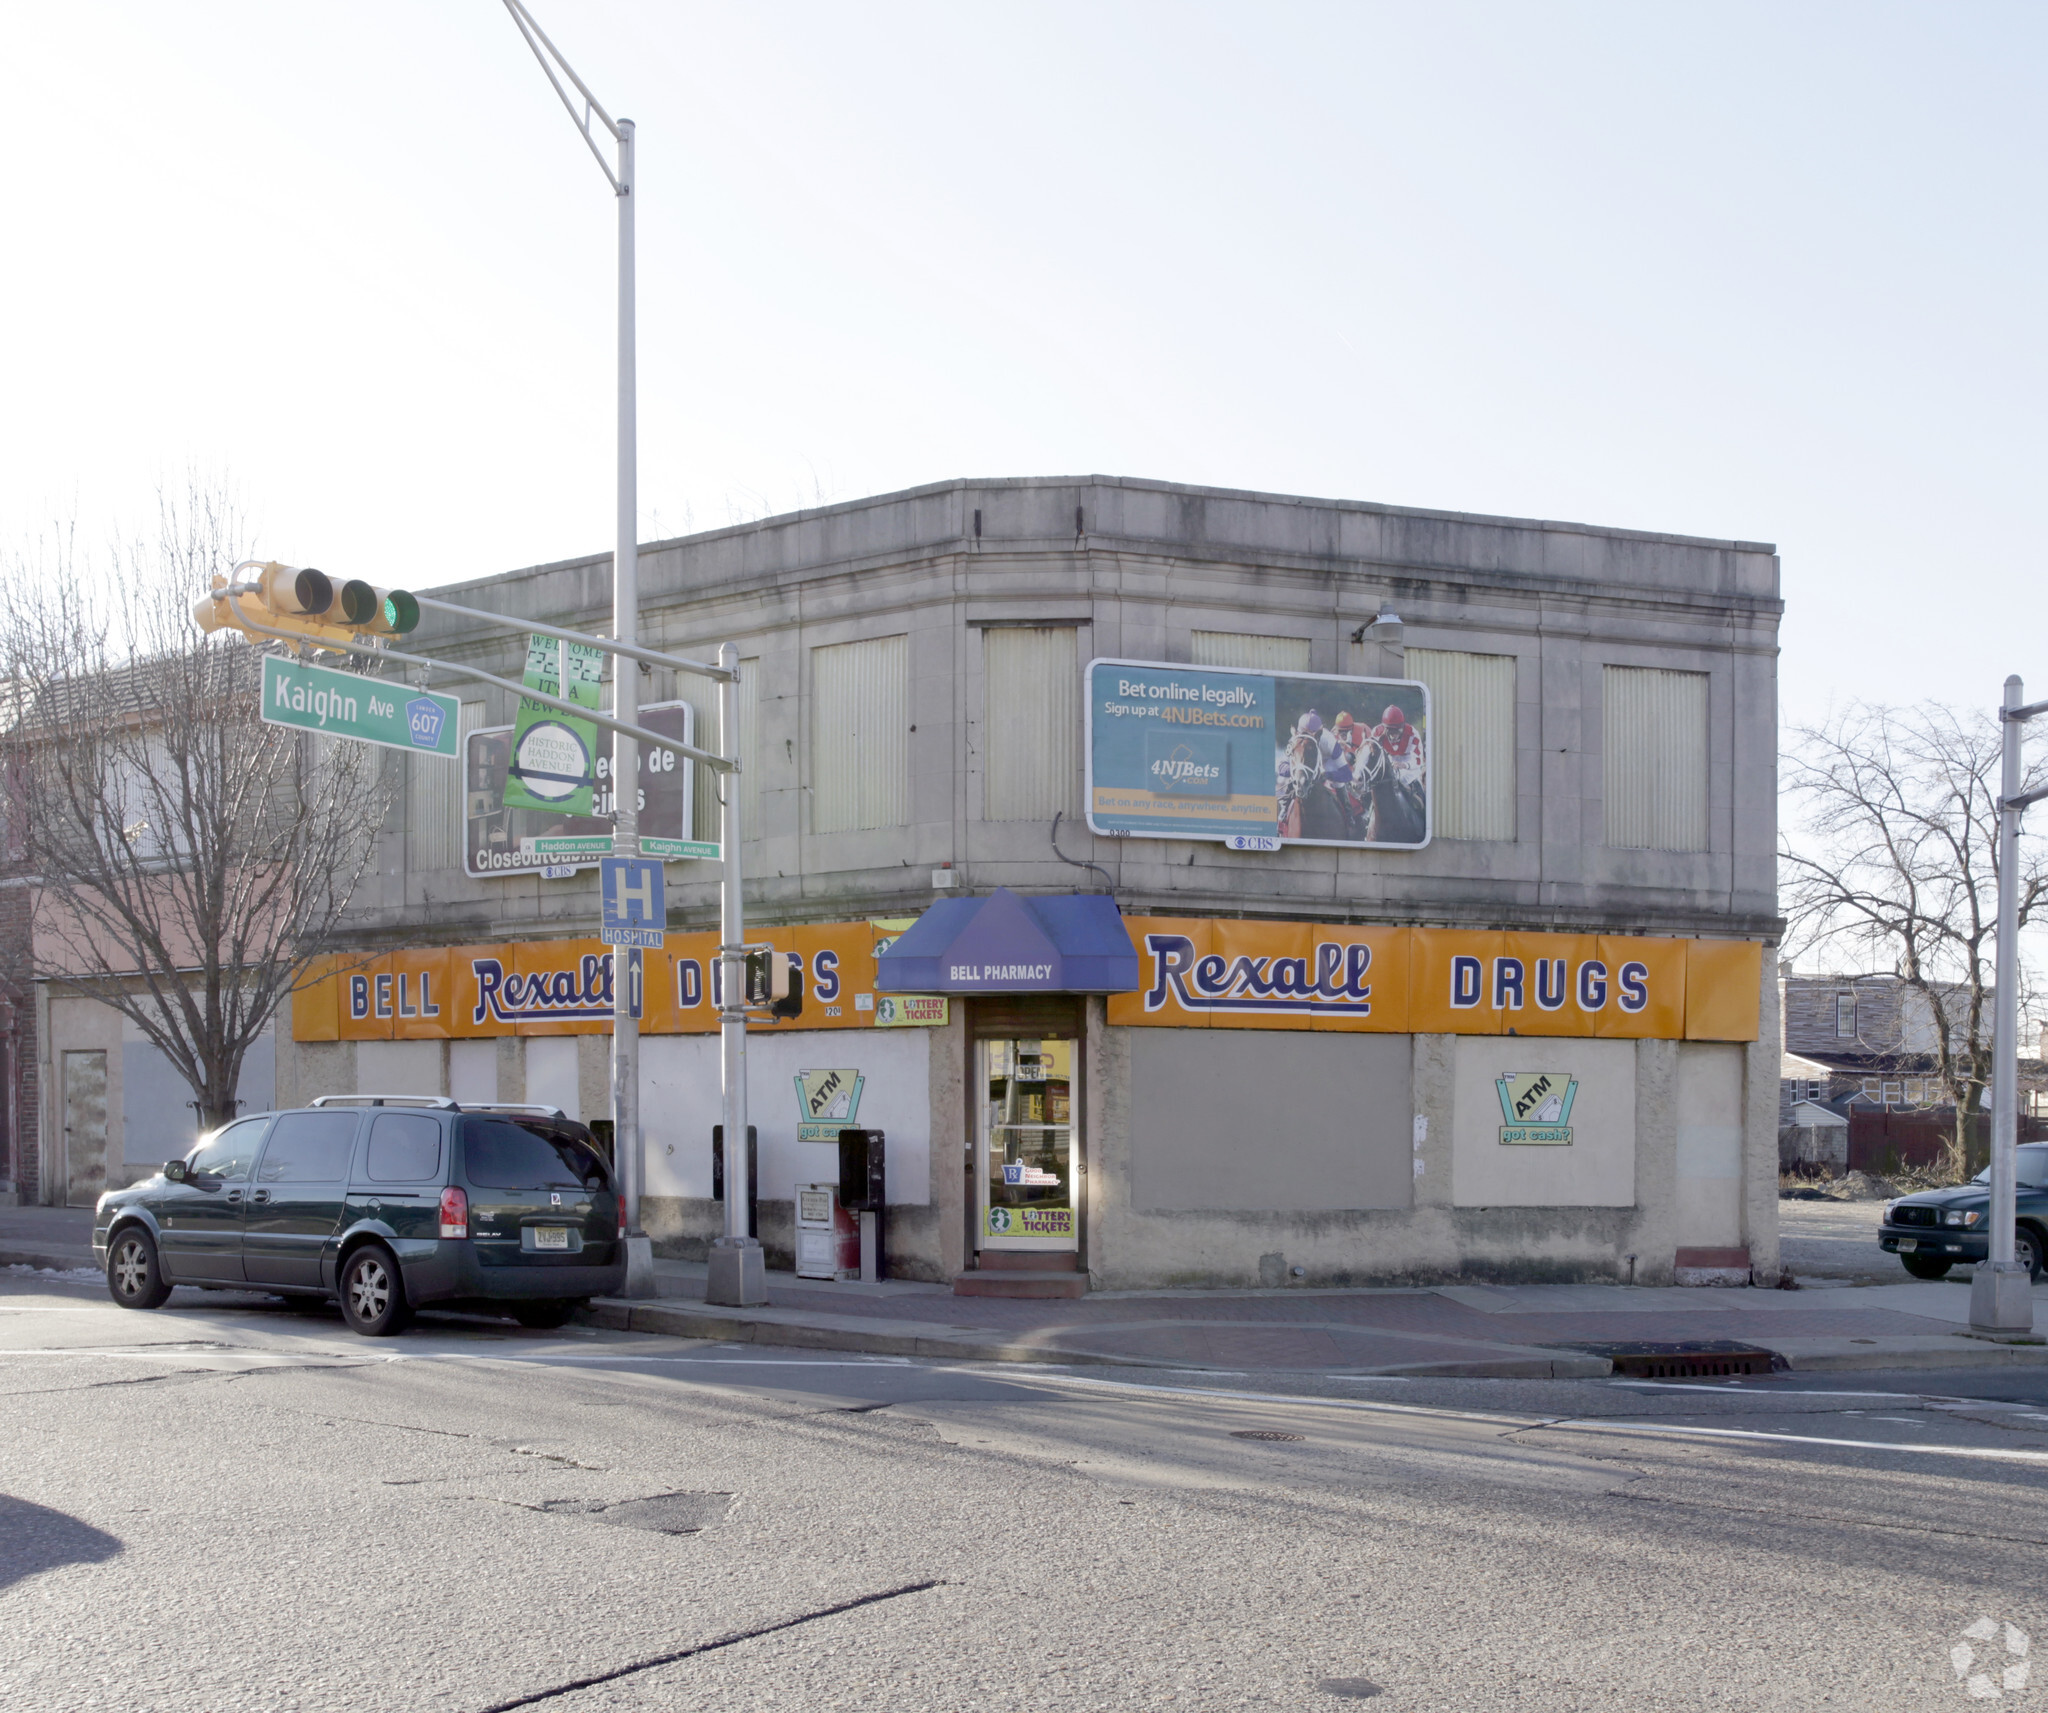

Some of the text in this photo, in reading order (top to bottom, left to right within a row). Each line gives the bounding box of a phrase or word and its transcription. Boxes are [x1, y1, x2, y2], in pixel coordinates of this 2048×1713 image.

[531, 635, 603, 659] WELOME
[275, 674, 394, 726] Kaighn Ave
[568, 685, 579, 700] A
[1118, 679, 1256, 709] Bet online legally.
[411, 712, 439, 735] 607
[1104, 701, 1265, 729] Sign up at 4NJBets.com
[527, 736, 577, 753] HISTORIC
[527, 747, 576, 763] HADDON
[648, 746, 676, 774] de
[528, 758, 573, 773] AVENUE
[1151, 759, 1220, 780] 4NJBets
[1098, 796, 1116, 807] Bet
[1117, 798, 1131, 807] on
[1133, 799, 1151, 810] any
[1152, 800, 1177, 811] race,
[1178, 801, 1230, 814] anywhere,
[1109, 829, 1131, 838] 0300
[541, 841, 576, 851] Haddon
[577, 842, 606, 850] AVENUE
[649, 840, 713, 855] Kaighn AVENUE
[1247, 837, 1274, 850] CBS
[554, 865, 572, 877] CBS
[614, 866, 653, 921] H
[604, 929, 662, 948] HOSPITAL
[950, 964, 1052, 981] BELL PHARMACY
[1144, 933, 1649, 1014] Rexall DRUGS
[350, 972, 440, 1020] BELL
[472, 954, 615, 1025] Rexall
[905, 1009, 944, 1020] TICKETS
[810, 1071, 842, 1115] ATM
[1515, 1075, 1552, 1119] ATM
[800, 1125, 820, 1139] got
[1503, 1128, 1570, 1143] got cash?
[1023, 1221, 1071, 1232] TICKETS
